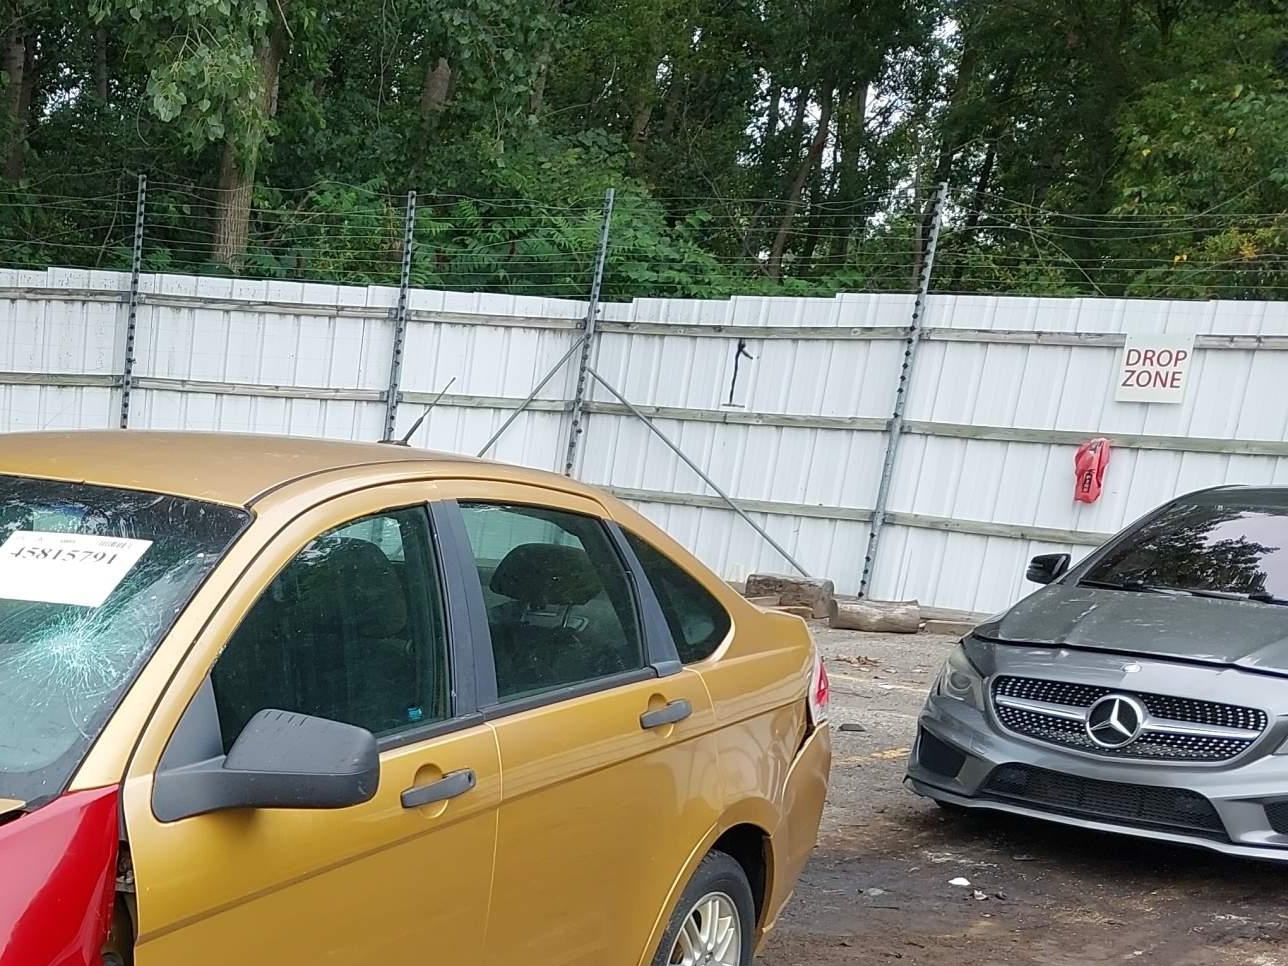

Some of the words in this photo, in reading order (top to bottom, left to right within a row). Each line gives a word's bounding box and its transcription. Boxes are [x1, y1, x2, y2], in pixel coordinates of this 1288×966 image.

[1125, 348, 1188, 368] DROP
[1121, 369, 1183, 389] ZONE
[10, 546, 118, 565] 45815791
